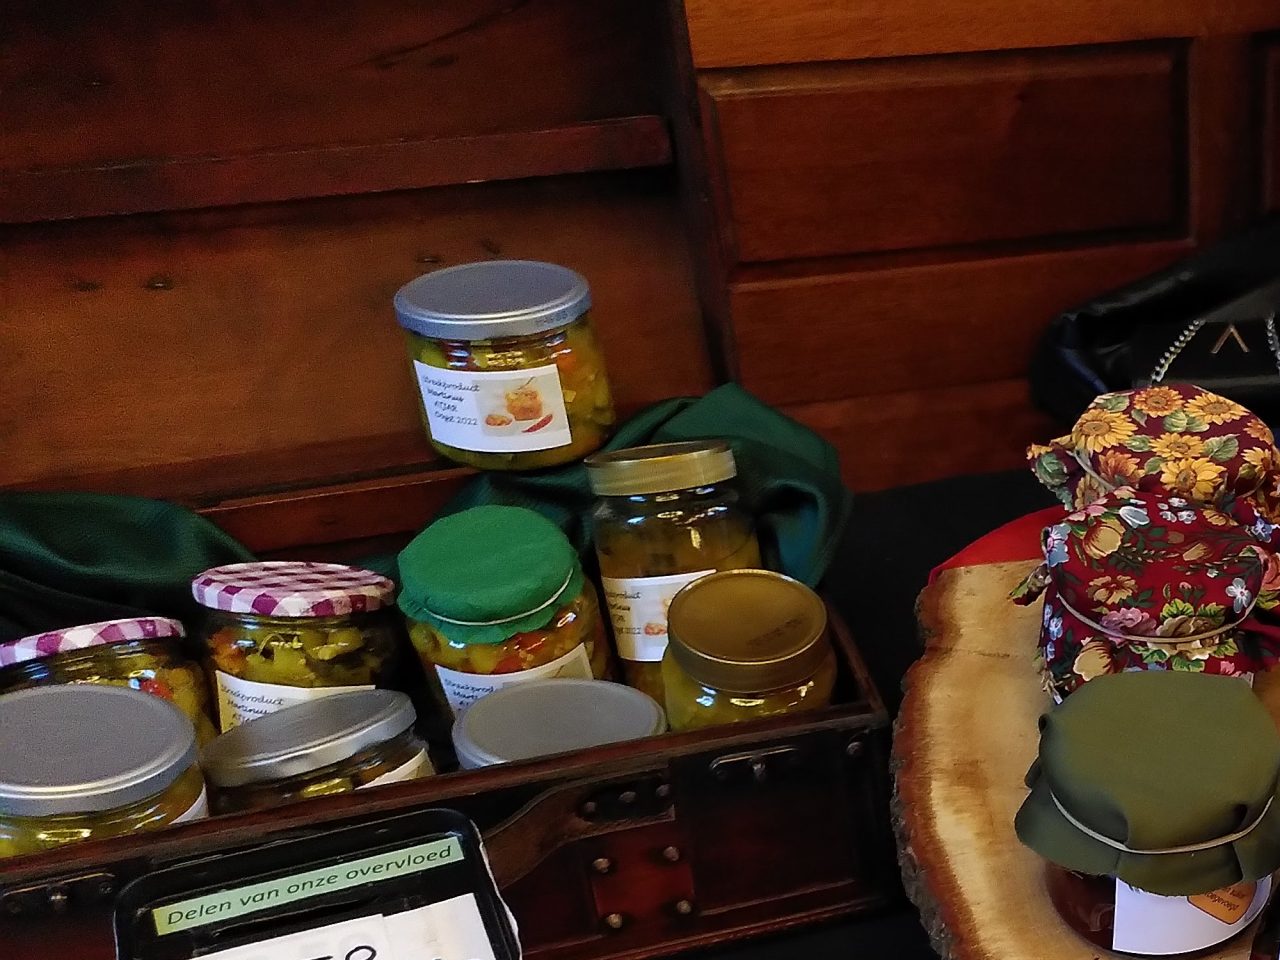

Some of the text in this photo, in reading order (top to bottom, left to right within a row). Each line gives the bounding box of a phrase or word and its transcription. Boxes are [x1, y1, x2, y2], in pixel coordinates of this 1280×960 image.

[167, 845, 452, 926] Delen van onze overvloed
